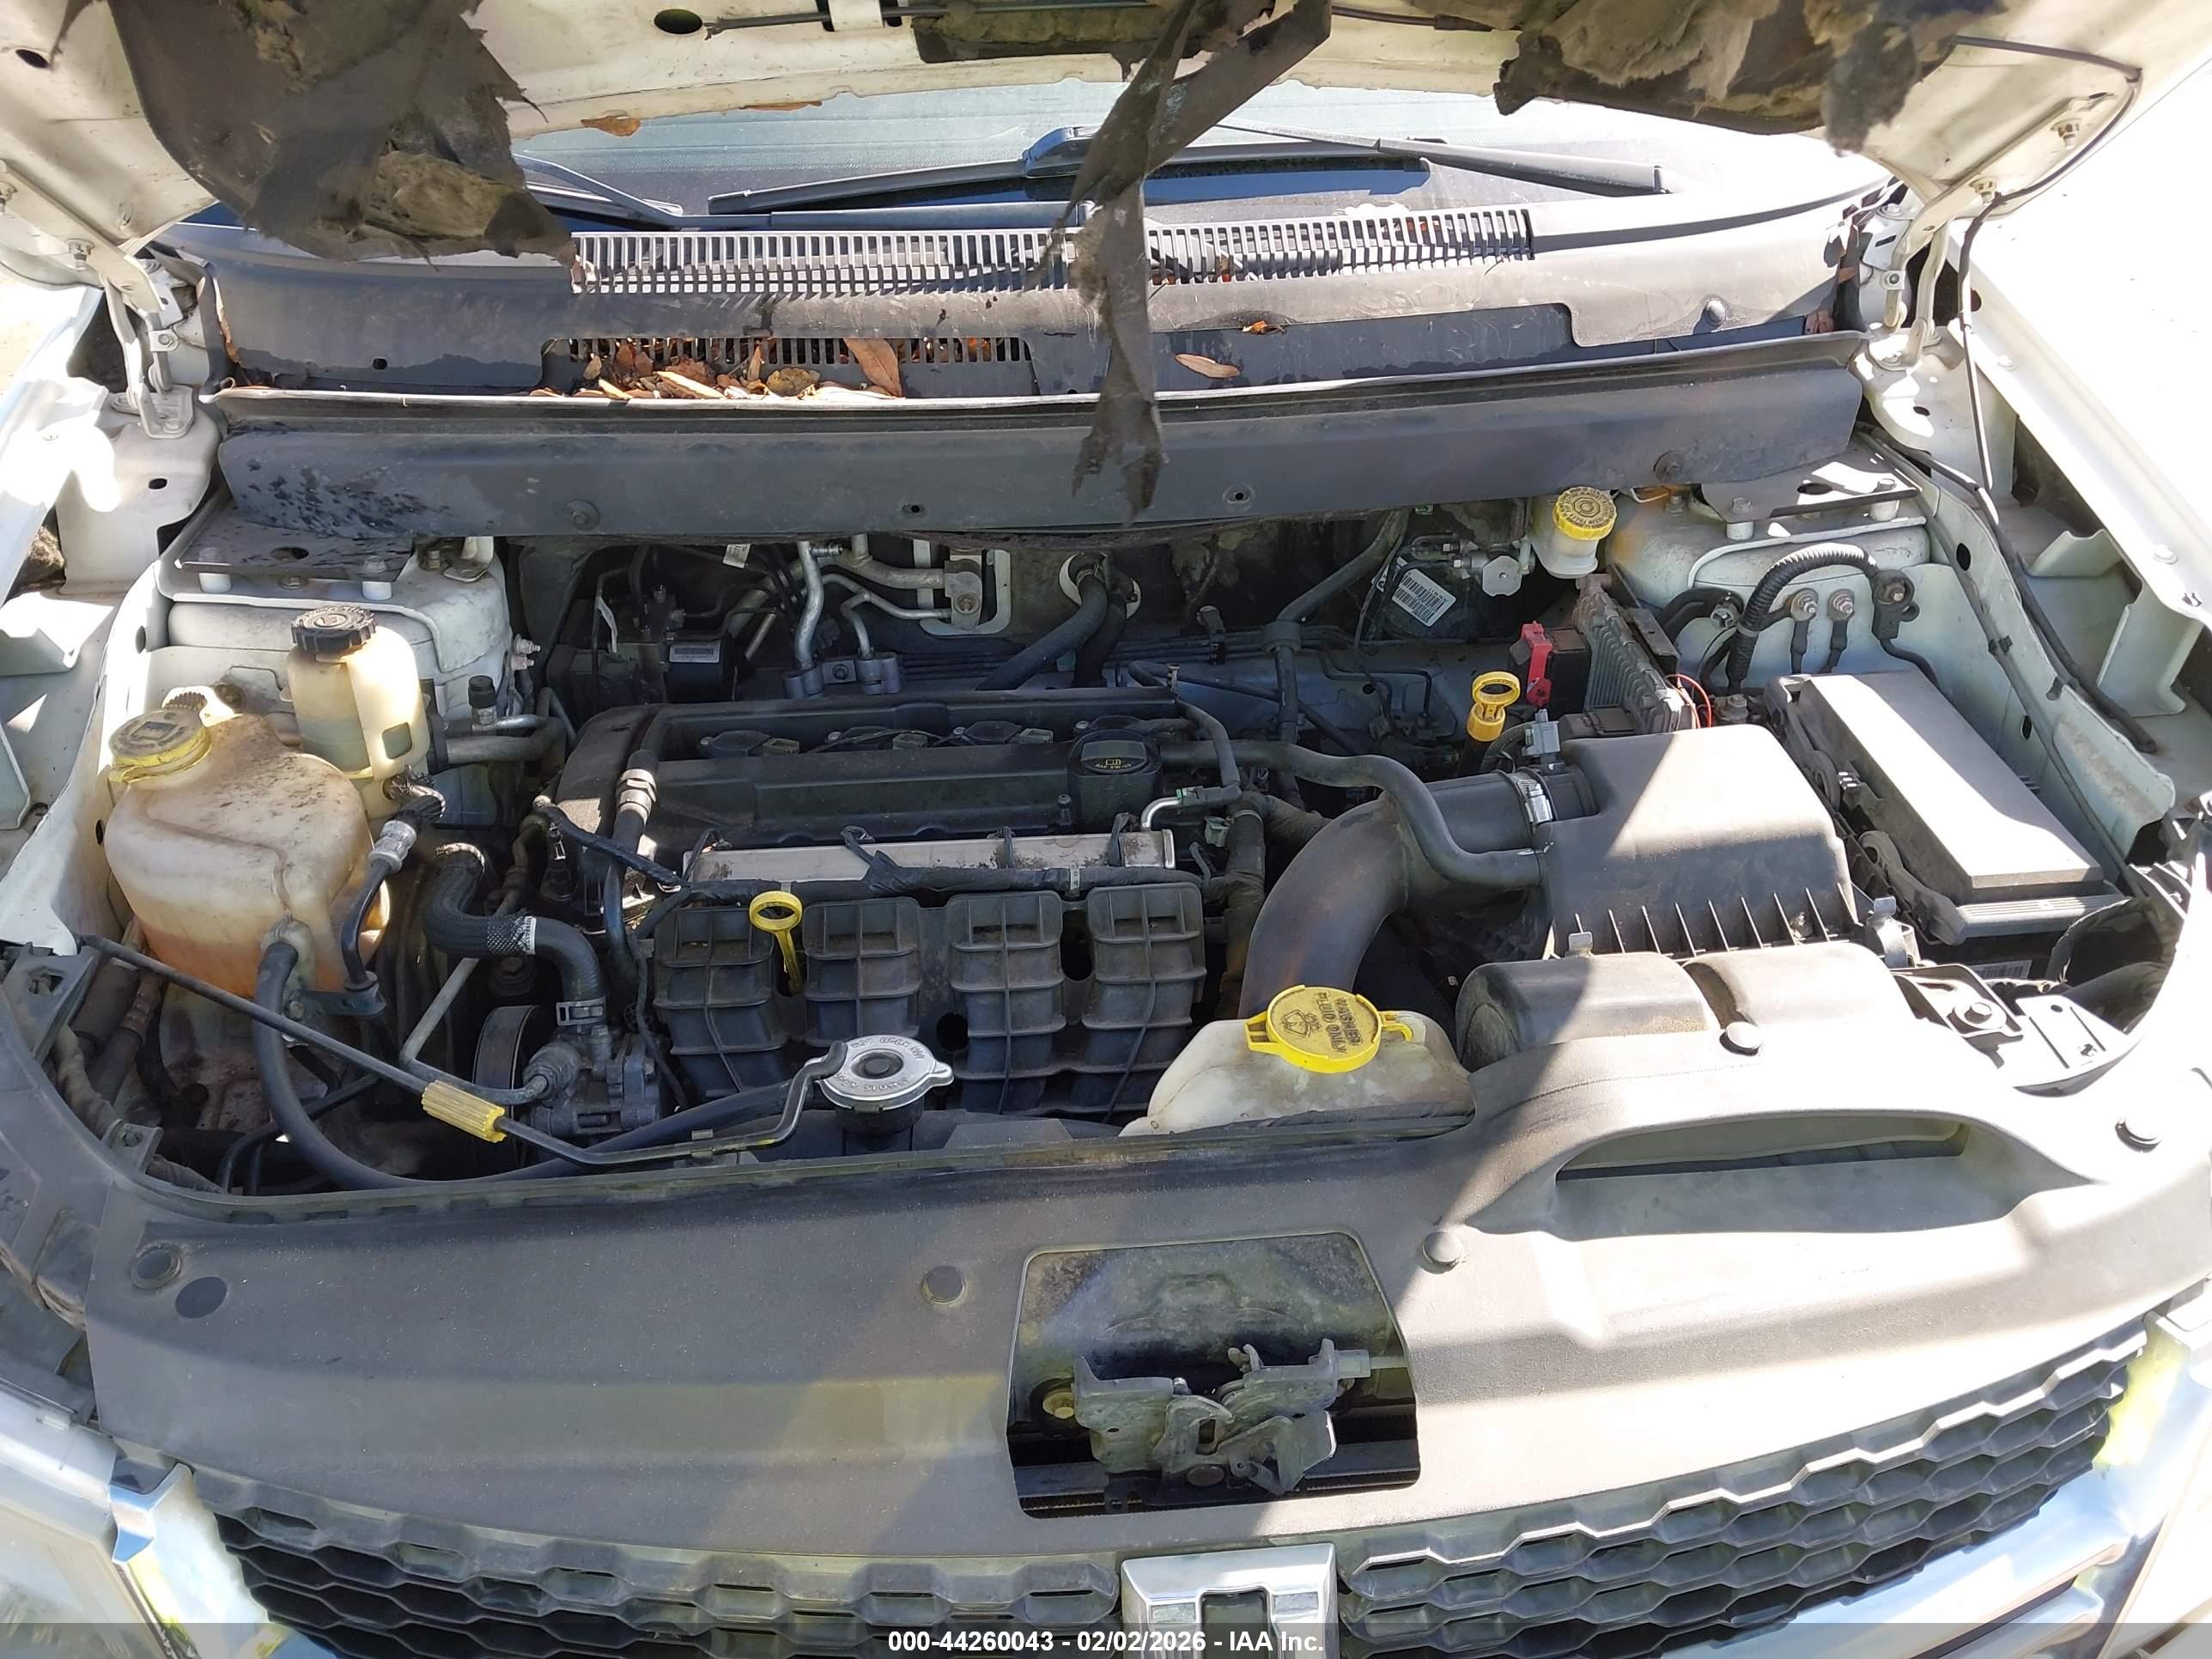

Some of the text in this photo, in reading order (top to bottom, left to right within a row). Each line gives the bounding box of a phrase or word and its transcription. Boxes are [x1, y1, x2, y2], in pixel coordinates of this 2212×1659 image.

[1316, 991, 1347, 1053] FLUID ONLY
[1336, 997, 1363, 1045] WASHER
